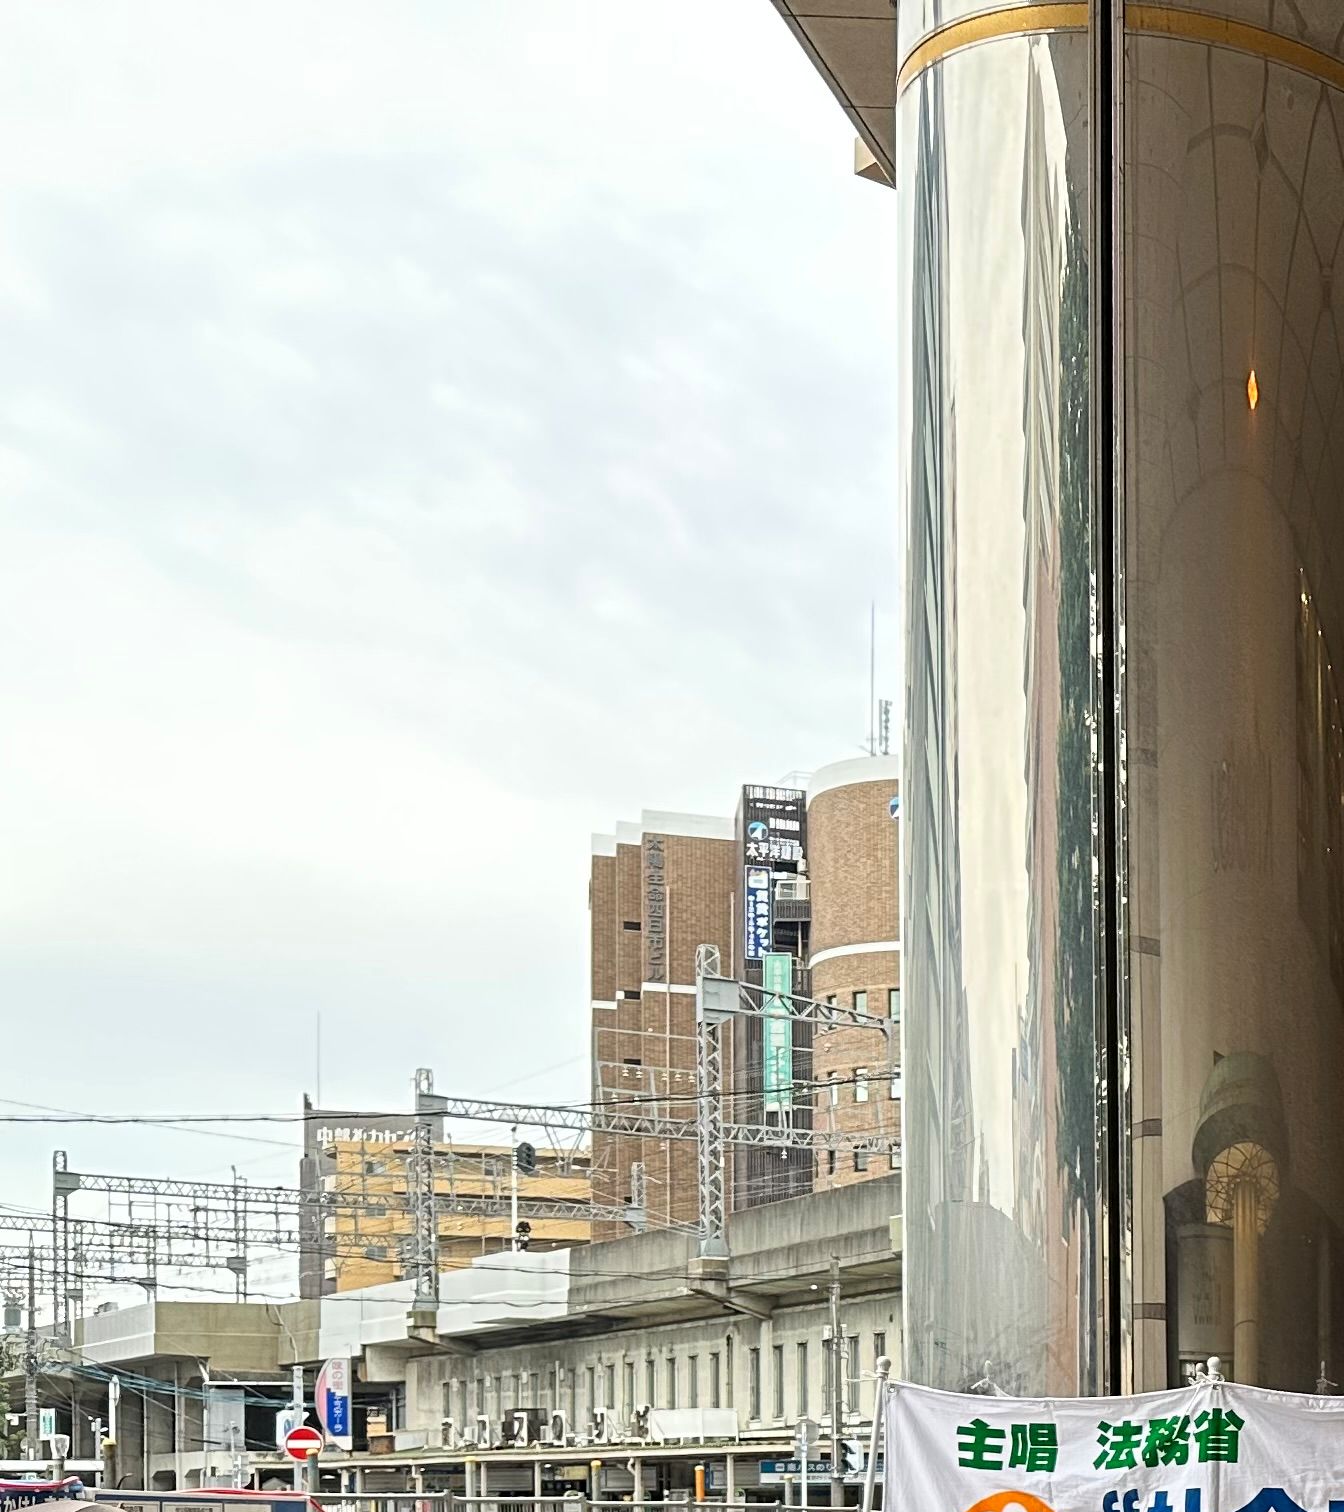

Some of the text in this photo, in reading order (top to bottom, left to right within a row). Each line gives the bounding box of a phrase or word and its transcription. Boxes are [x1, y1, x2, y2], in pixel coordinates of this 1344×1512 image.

[956, 1417, 1059, 1473] 主唱
[1092, 1408, 1246, 1471] 法務省
